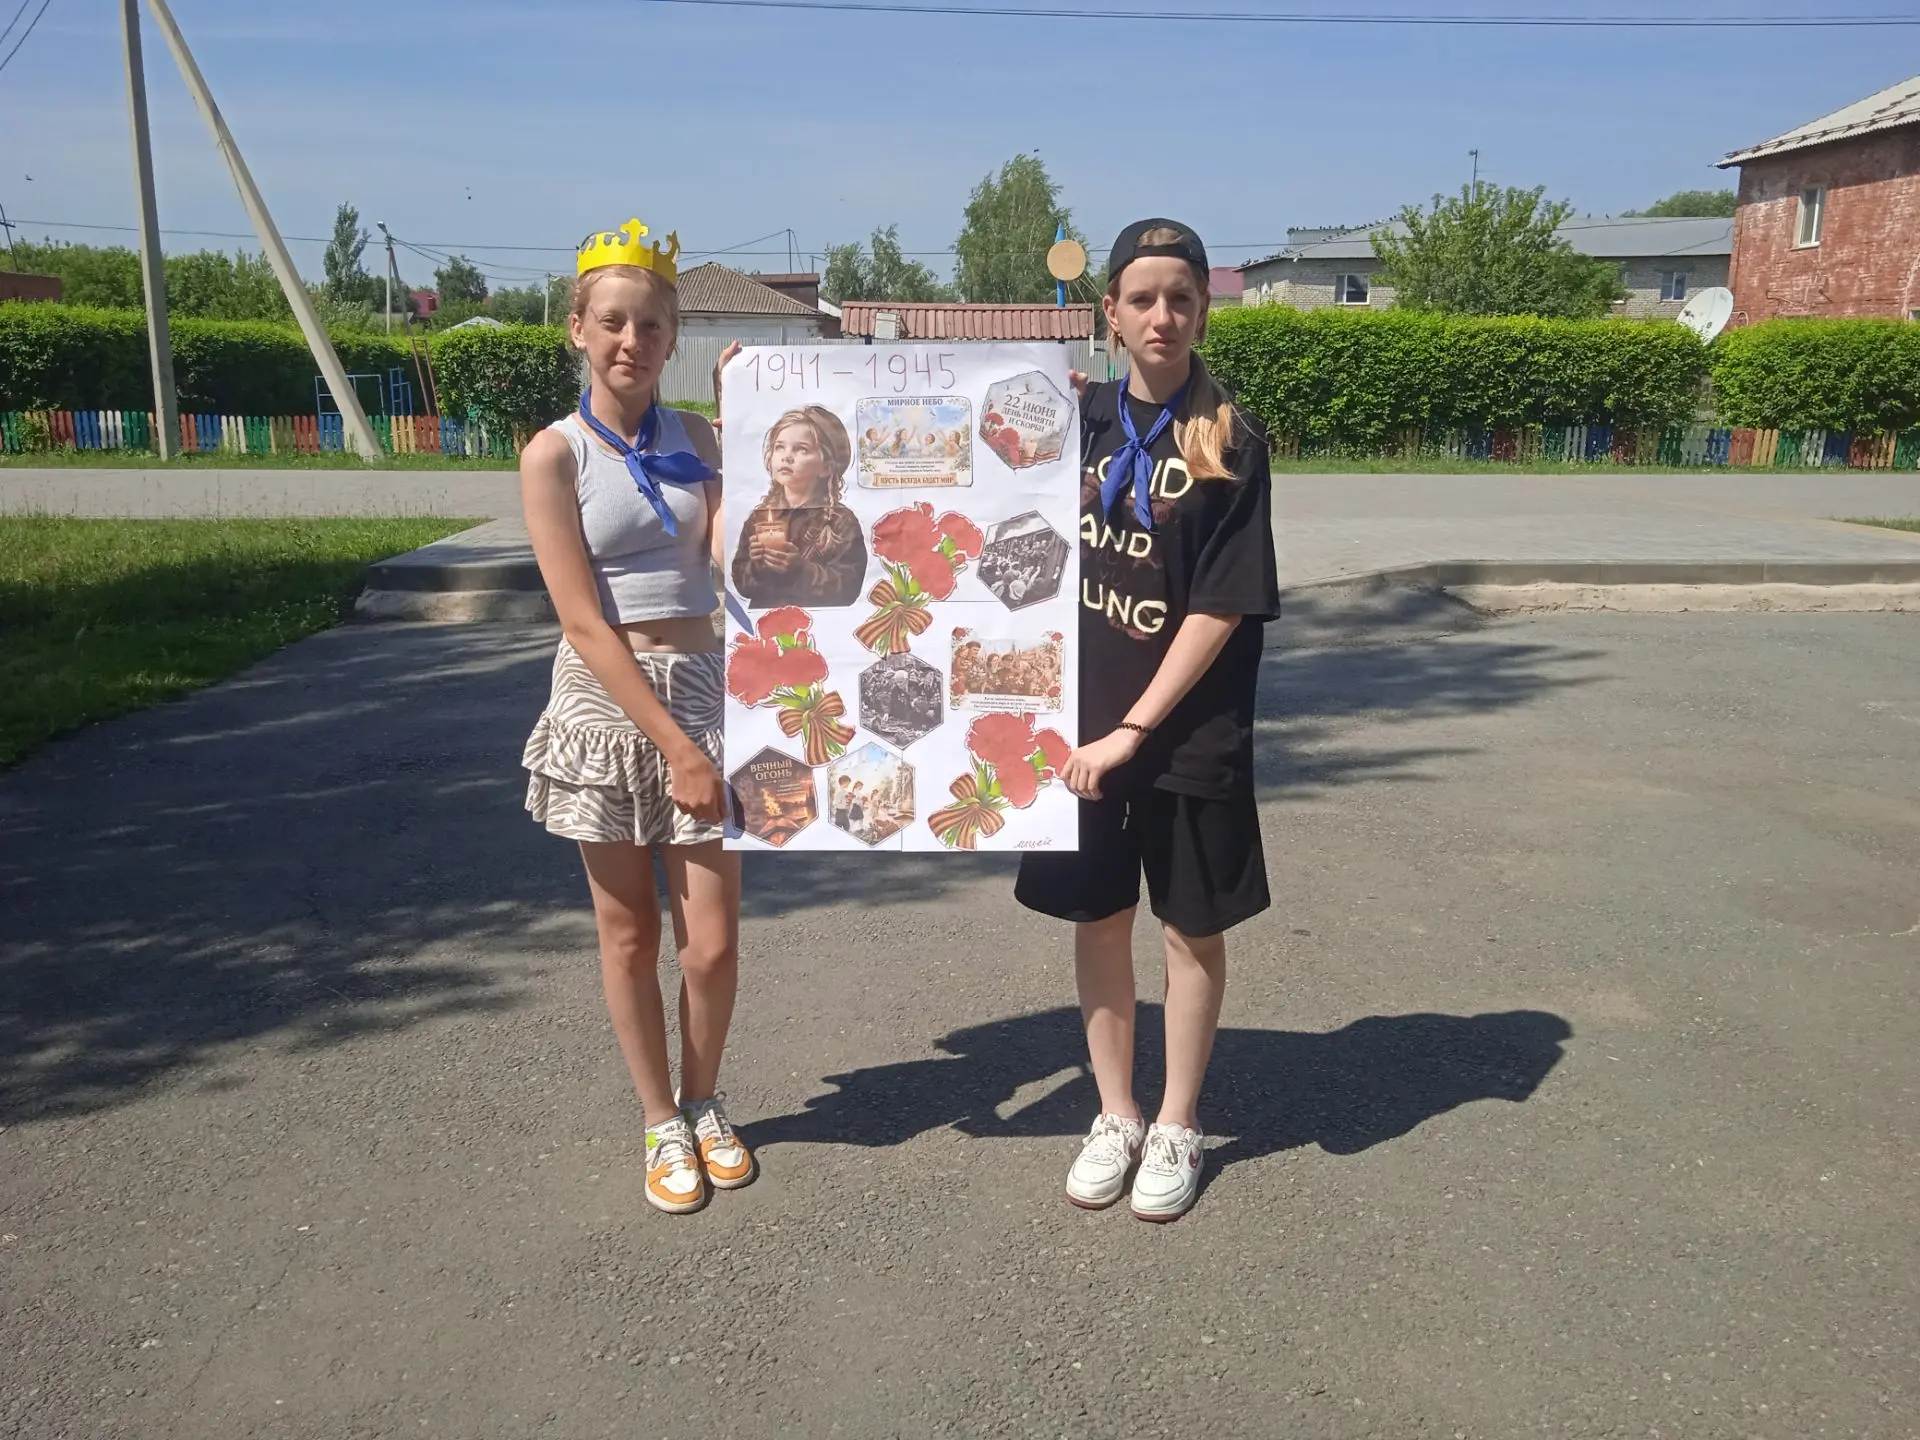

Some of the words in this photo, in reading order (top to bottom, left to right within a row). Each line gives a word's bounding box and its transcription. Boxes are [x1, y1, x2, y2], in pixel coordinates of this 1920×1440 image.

[746, 353, 820, 392] 1941
[865, 353, 956, 393] 1945
[922, 398, 943, 406] НЕБО
[1003, 394, 1021, 409] 22
[1022, 401, 1057, 419] ИЮНЯ
[1001, 407, 1021, 418] ДЕНЬ
[1022, 414, 1055, 427] ПАМЯТИ
[1015, 419, 1045, 433] СКОРБИ
[1080, 513, 1153, 558] AND
[750, 759, 793, 773] ВЕЧНЫЙ
[755, 769, 793, 781] ОГОНЬ
